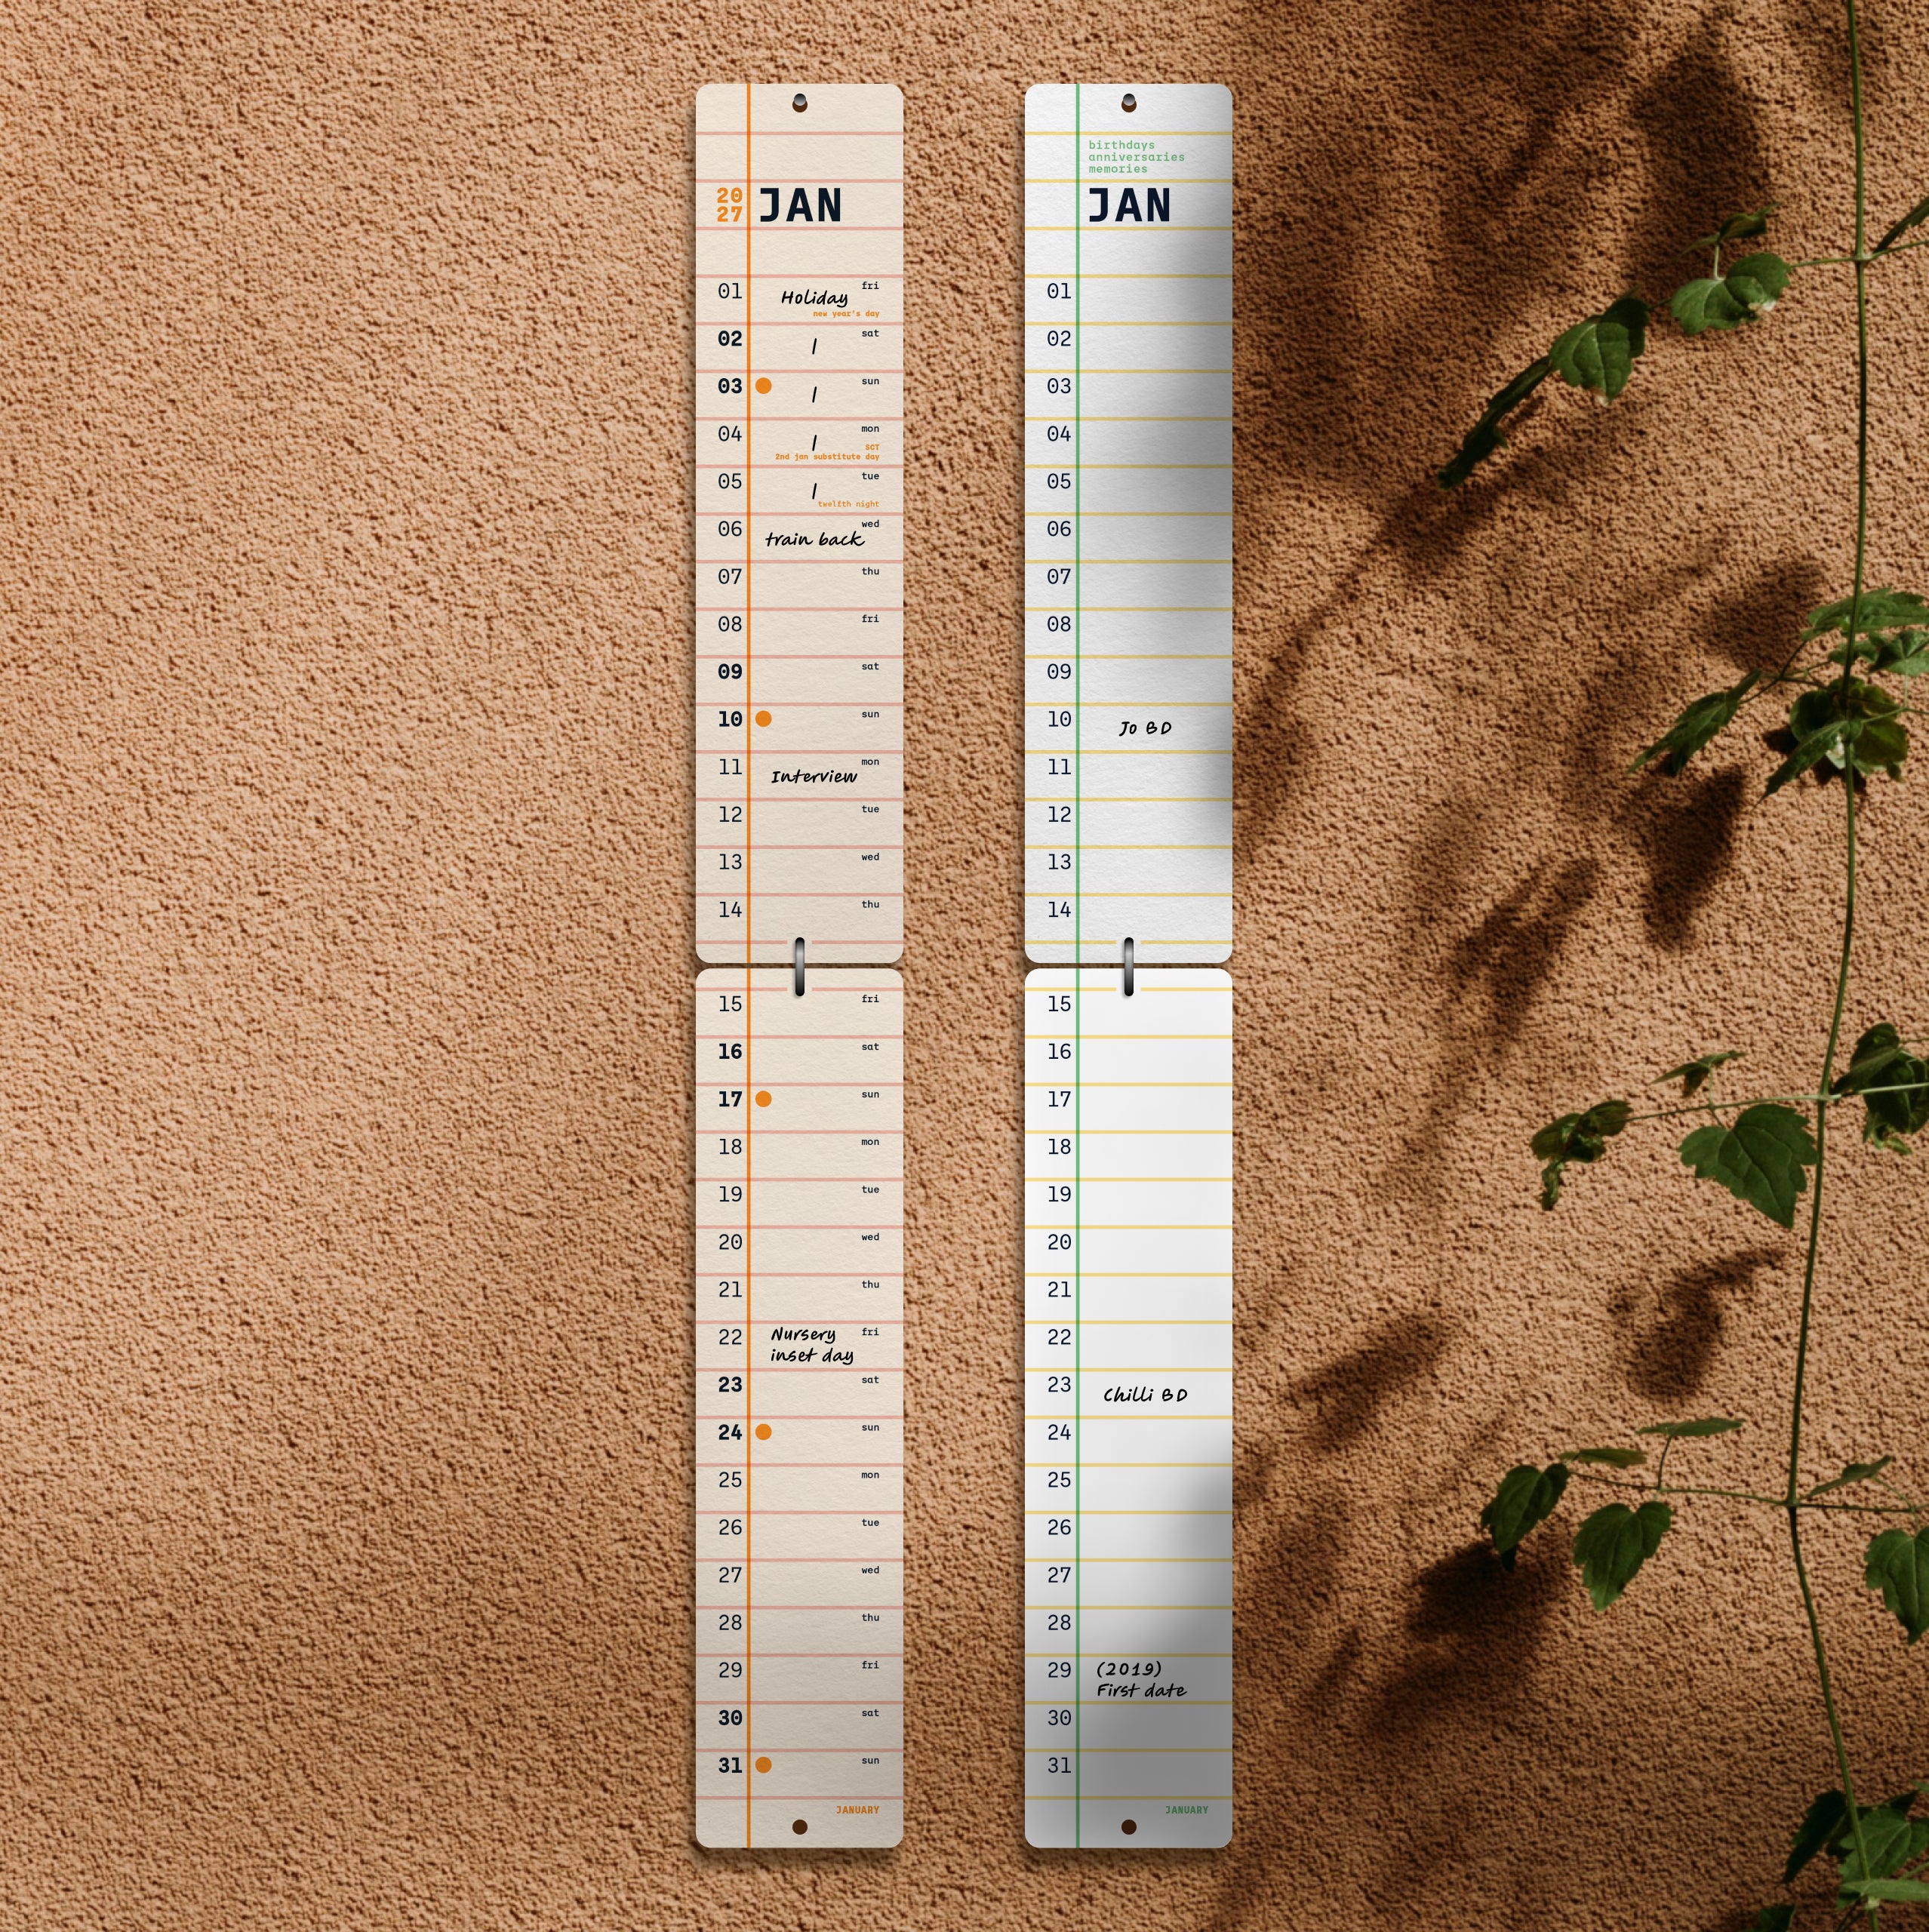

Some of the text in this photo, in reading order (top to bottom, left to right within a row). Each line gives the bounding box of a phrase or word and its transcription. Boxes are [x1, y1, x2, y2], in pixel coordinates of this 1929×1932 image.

[1088, 140, 1155, 151] birthdays
[1088, 152, 1185, 162] anniversaries
[1088, 164, 1148, 174] memories
[717, 186, 743, 204] 20
[760, 187, 841, 223] JAN
[1089, 187, 1170, 223] JAN
[716, 205, 743, 223] 27
[718, 282, 743, 300] 01
[862, 281, 880, 290] fri
[1047, 282, 1072, 300] 01
[781, 288, 848, 309] Holiday
[865, 309, 880, 318] day
[718, 330, 743, 346] 02
[862, 329, 879, 337] sat
[1047, 330, 1071, 346] 02
[718, 377, 743, 394] 03
[1047, 377, 1072, 394] 03
[718, 425, 743, 442] 04
[1047, 425, 1072, 442] 04
[865, 443, 880, 451] SCT
[775, 452, 790, 460] 2nd
[864, 452, 880, 461] day
[718, 472, 742, 490] 05
[861, 472, 880, 480] tue
[1047, 472, 1071, 490] 05
[855, 500, 879, 509] night
[718, 520, 743, 537] 06
[861, 519, 880, 528] wed
[1047, 520, 1072, 537] 06
[765, 530, 866, 547] train back
[718, 568, 743, 585] 07
[861, 567, 880, 576] thu
[1047, 568, 1072, 585] 07
[718, 615, 743, 632] 08
[862, 614, 880, 623] fri
[1047, 615, 1071, 632] 08
[718, 663, 743, 680] 09
[862, 662, 879, 670] sat
[1047, 663, 1072, 680] 09
[718, 710, 743, 728] 10
[1048, 710, 1072, 728] 10
[1118, 721, 1137, 737] Jo
[719, 758, 743, 775] 11
[1048, 758, 1072, 775] 11
[771, 768, 858, 784] Interview
[719, 805, 742, 823] 12
[861, 804, 880, 813] tue
[1048, 806, 1071, 823] 12
[719, 853, 743, 870] 13
[861, 852, 880, 861] wed
[1048, 853, 1072, 870] 13
[719, 901, 743, 918] 14
[861, 900, 880, 909] thu
[1048, 901, 1072, 918] 14
[719, 995, 742, 1012] 15
[862, 994, 880, 1003] fri
[1048, 995, 1071, 1012] 15
[718, 1043, 743, 1060] 16
[862, 1042, 879, 1051] sat
[1048, 1043, 1072, 1060] 16
[718, 1091, 743, 1107] 17
[1048, 1091, 1072, 1107] 17
[719, 1138, 743, 1155] 18
[1048, 1138, 1072, 1155] 18
[719, 1186, 743, 1202] 19
[861, 1185, 880, 1194] tue
[1048, 1186, 1072, 1202] 19
[718, 1233, 743, 1251] 20
[861, 1232, 879, 1241] wed
[1048, 1233, 1072, 1251] 20
[718, 1281, 743, 1298] 21
[861, 1280, 879, 1289] thu
[1048, 1281, 1072, 1298] 21
[718, 1328, 742, 1346] 22
[771, 1326, 836, 1345] Nursery
[862, 1327, 880, 1336] fri
[1048, 1328, 1071, 1346] 22
[771, 1346, 854, 1366] inset day
[718, 1376, 743, 1392] 23
[862, 1376, 879, 1384] sat
[1048, 1376, 1071, 1392] 23
[1103, 1386, 1154, 1403] Chilli
[718, 1423, 743, 1441] 24
[1048, 1423, 1072, 1441] 24
[718, 1471, 742, 1488] 25
[1048, 1471, 1071, 1488] 25
[718, 1518, 743, 1536] 26
[861, 1518, 880, 1527] tue
[1048, 1518, 1072, 1536] 26
[718, 1566, 743, 1583] 27
[861, 1565, 880, 1574] wed
[1048, 1566, 1072, 1583] 27
[718, 1614, 743, 1631] 28
[861, 1613, 880, 1622] thu
[1048, 1614, 1071, 1631] 28
[718, 1661, 743, 1678] 29
[862, 1660, 879, 1669] fri
[1048, 1661, 1072, 1678] 29
[1097, 1660, 1161, 1678] (2019)
[1097, 1682, 1188, 1698] First date
[718, 1709, 743, 1726] 30
[862, 1709, 879, 1717] sat
[1048, 1709, 1072, 1726] 30
[718, 1757, 743, 1774] 31
[1048, 1757, 1072, 1774] 31
[837, 1805, 879, 1814] JANUARY
[1166, 1805, 1208, 1814] JANUARY
